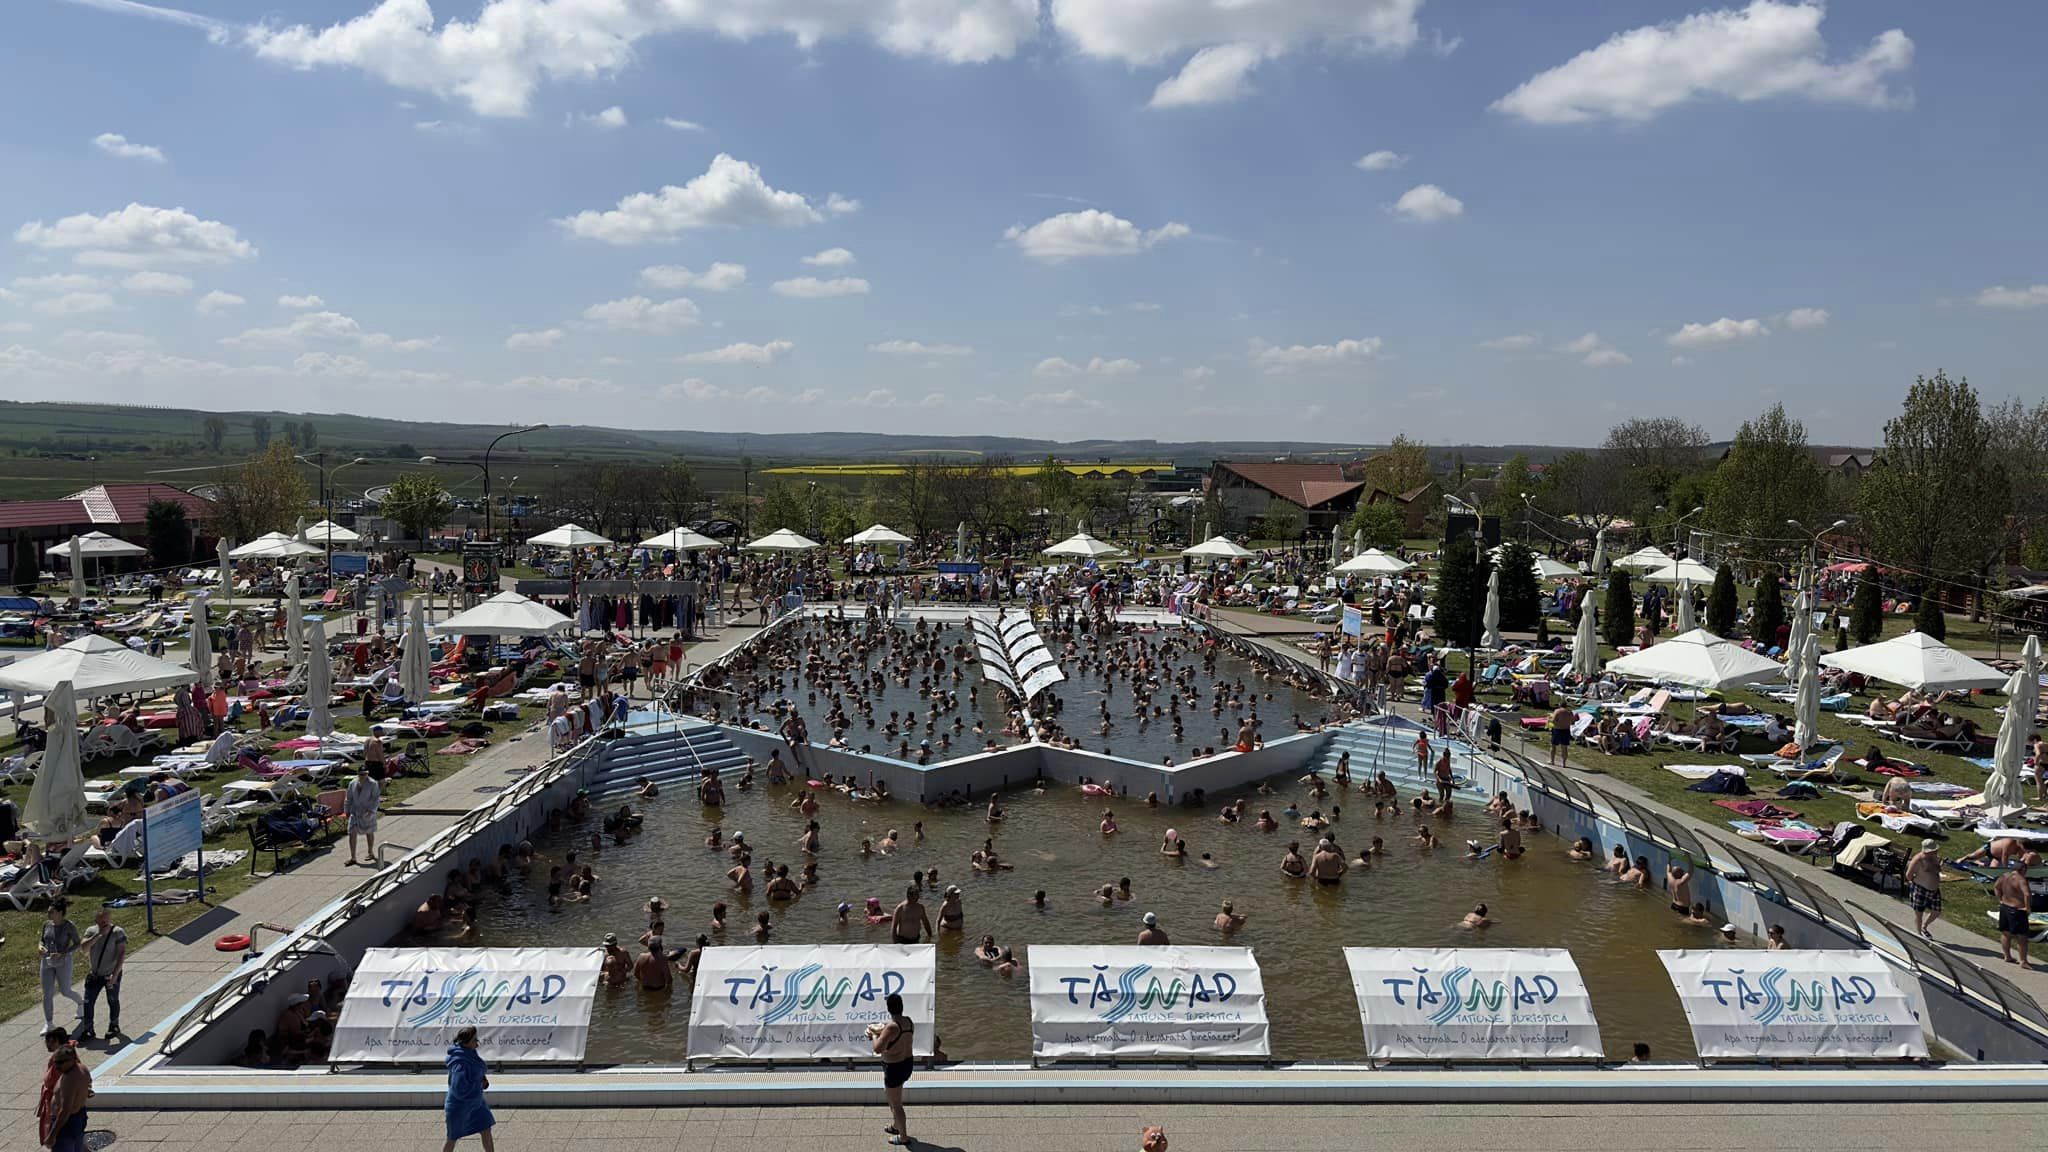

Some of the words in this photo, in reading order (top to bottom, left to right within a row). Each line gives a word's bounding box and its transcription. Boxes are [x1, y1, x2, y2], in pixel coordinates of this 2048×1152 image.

[365, 1036, 383, 1050] Apa
[434, 1035, 441, 1047] O
[718, 1033, 736, 1049] Apa
[786, 1032, 793, 1043] O
[1064, 1032, 1082, 1046] Apa
[1130, 1031, 1136, 1042] O
[1396, 1033, 1414, 1048] Apa
[1461, 1032, 1467, 1043] O
[1724, 1033, 1742, 1047] Apa
[1788, 1031, 1793, 1043] O
